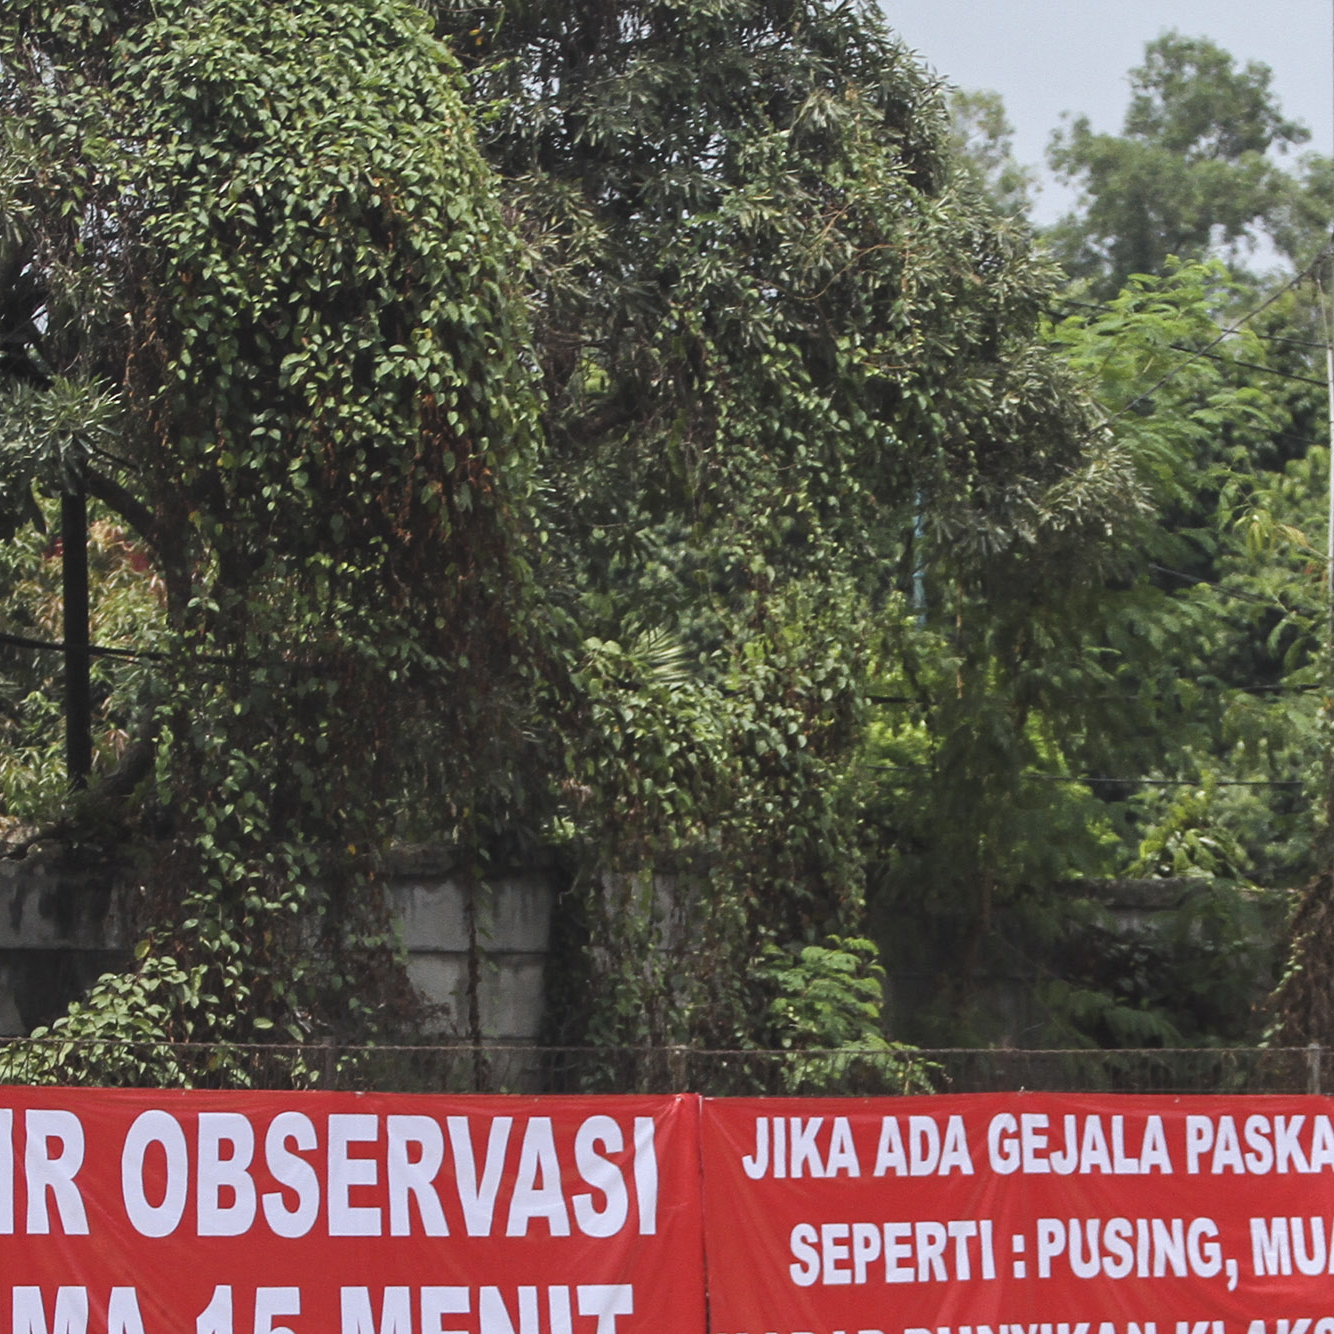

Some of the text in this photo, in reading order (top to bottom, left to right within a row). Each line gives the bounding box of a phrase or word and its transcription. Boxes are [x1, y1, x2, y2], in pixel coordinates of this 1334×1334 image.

[122, 1110, 657, 1238] OBSERVASI
[742, 1117, 860, 1179] JIKA
[874, 1116, 974, 1176] ADA
[988, 1113, 1172, 1175] GEJALA
[790, 1220, 995, 1286] SEPERTI
